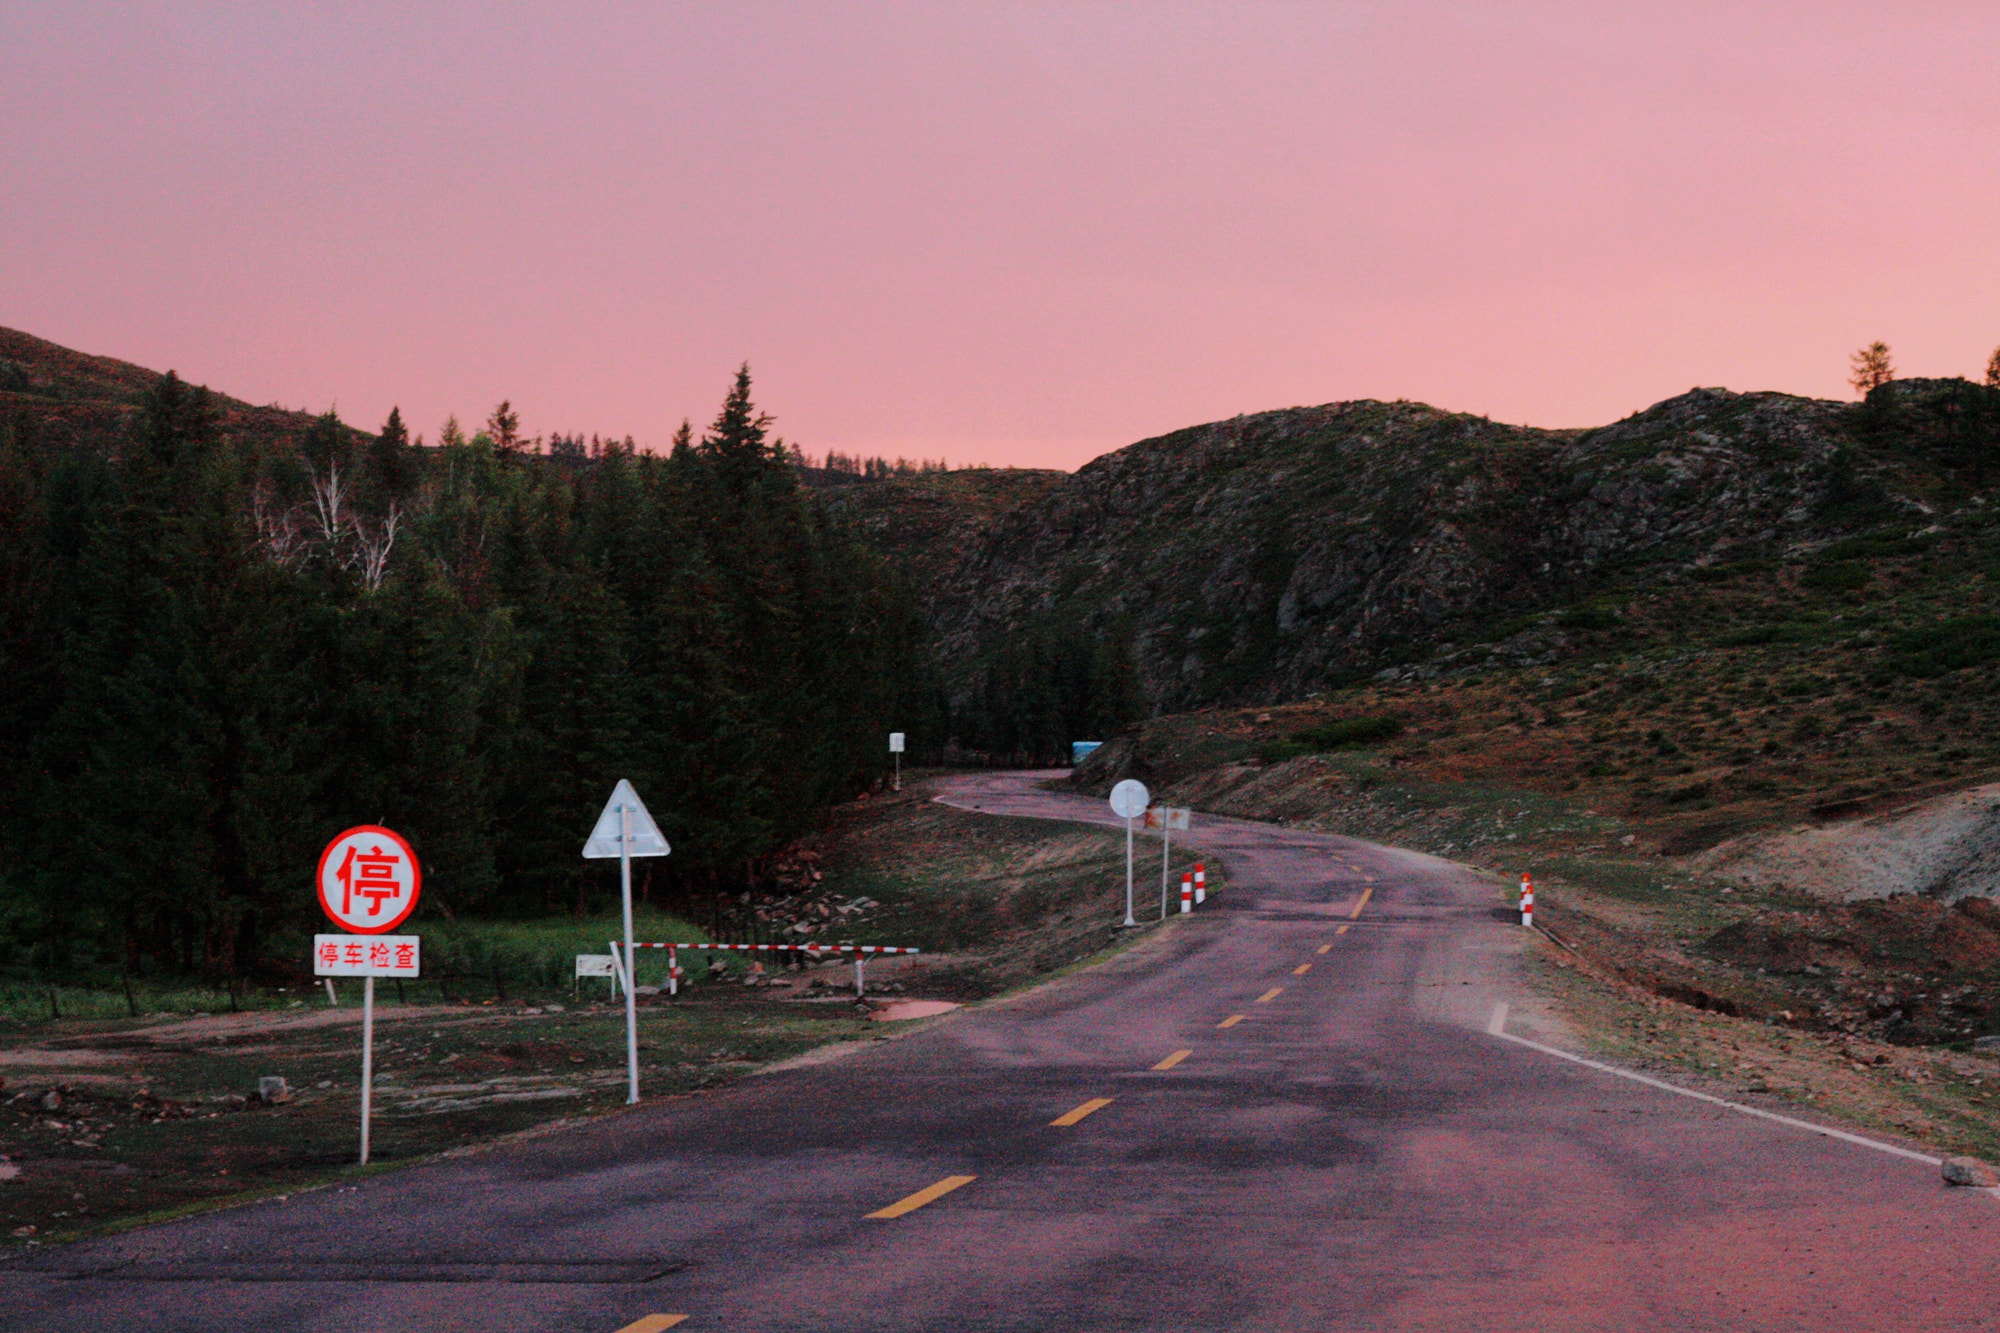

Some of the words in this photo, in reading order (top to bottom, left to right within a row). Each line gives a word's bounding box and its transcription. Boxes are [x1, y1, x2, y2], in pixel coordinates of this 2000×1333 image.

[335, 844, 401, 917] 停
[318, 942, 415, 969] 停车检查
